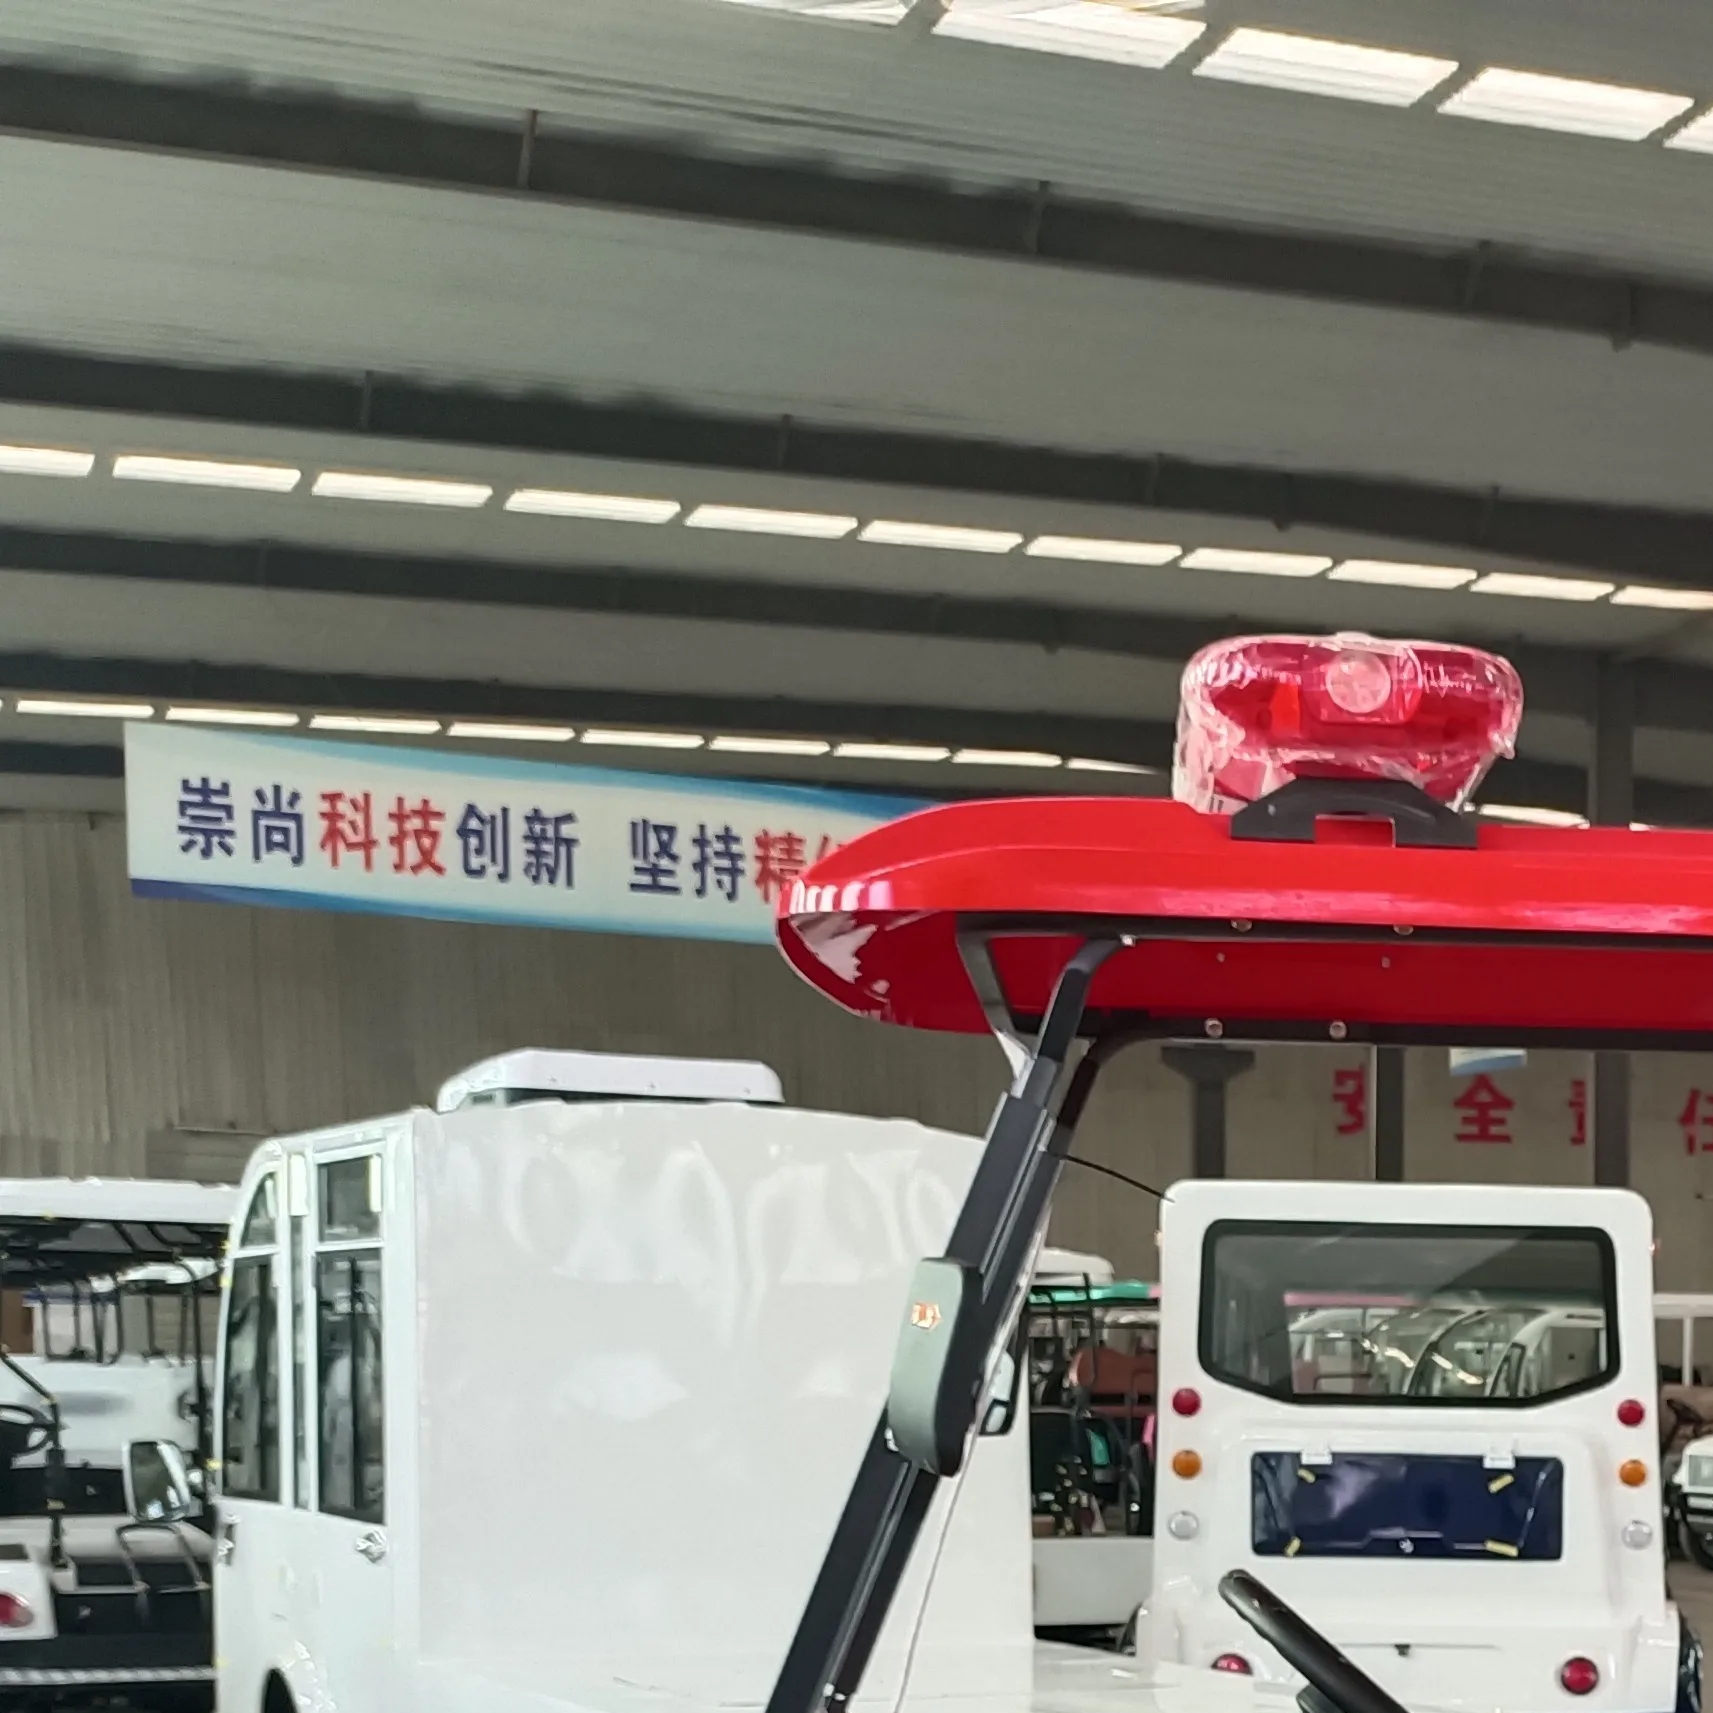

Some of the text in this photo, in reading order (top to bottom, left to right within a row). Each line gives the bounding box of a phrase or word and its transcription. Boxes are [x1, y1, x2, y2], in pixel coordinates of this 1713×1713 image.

[176, 776, 846, 904] 崇尚科技创新 坚持精
